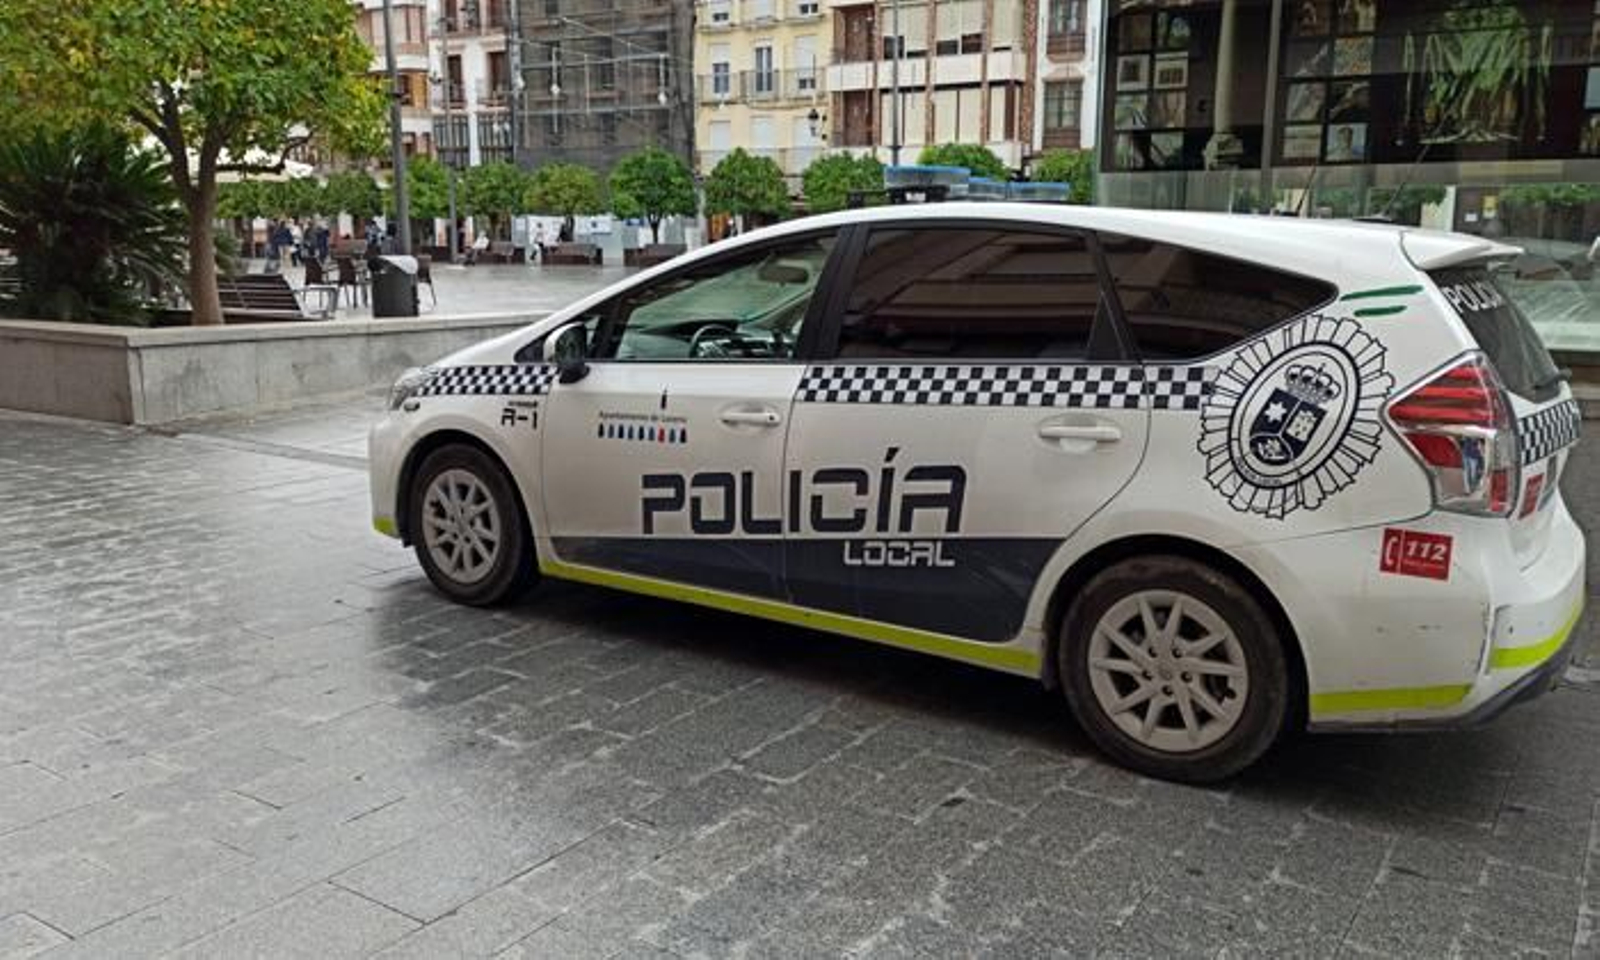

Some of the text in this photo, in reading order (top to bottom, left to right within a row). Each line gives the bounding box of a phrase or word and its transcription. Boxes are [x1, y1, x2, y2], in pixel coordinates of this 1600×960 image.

[641, 446, 967, 535] POLICÍA
[843, 540, 956, 567] LOCAL
[1406, 540, 1448, 562] 112
